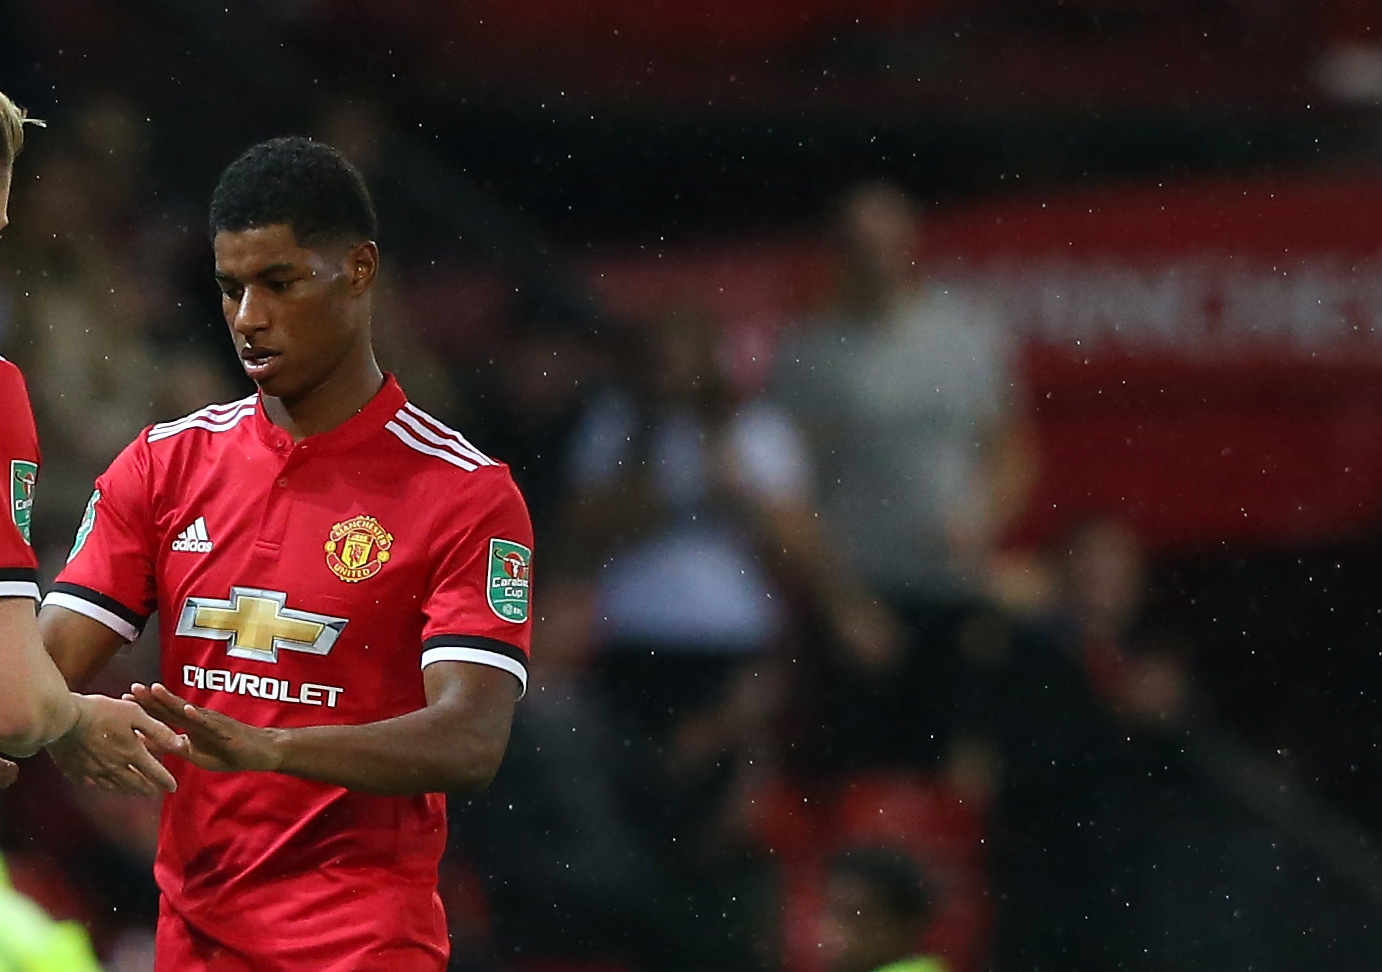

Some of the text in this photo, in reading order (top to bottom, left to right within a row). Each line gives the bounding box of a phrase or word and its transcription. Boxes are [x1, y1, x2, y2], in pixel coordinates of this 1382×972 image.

[334, 520, 388, 546] MANCHESTER
[172, 538, 213, 553] adidas
[333, 563, 370, 578] UNITED
[504, 587, 523, 598] Cup
[182, 664, 344, 708] CHEVROLET
